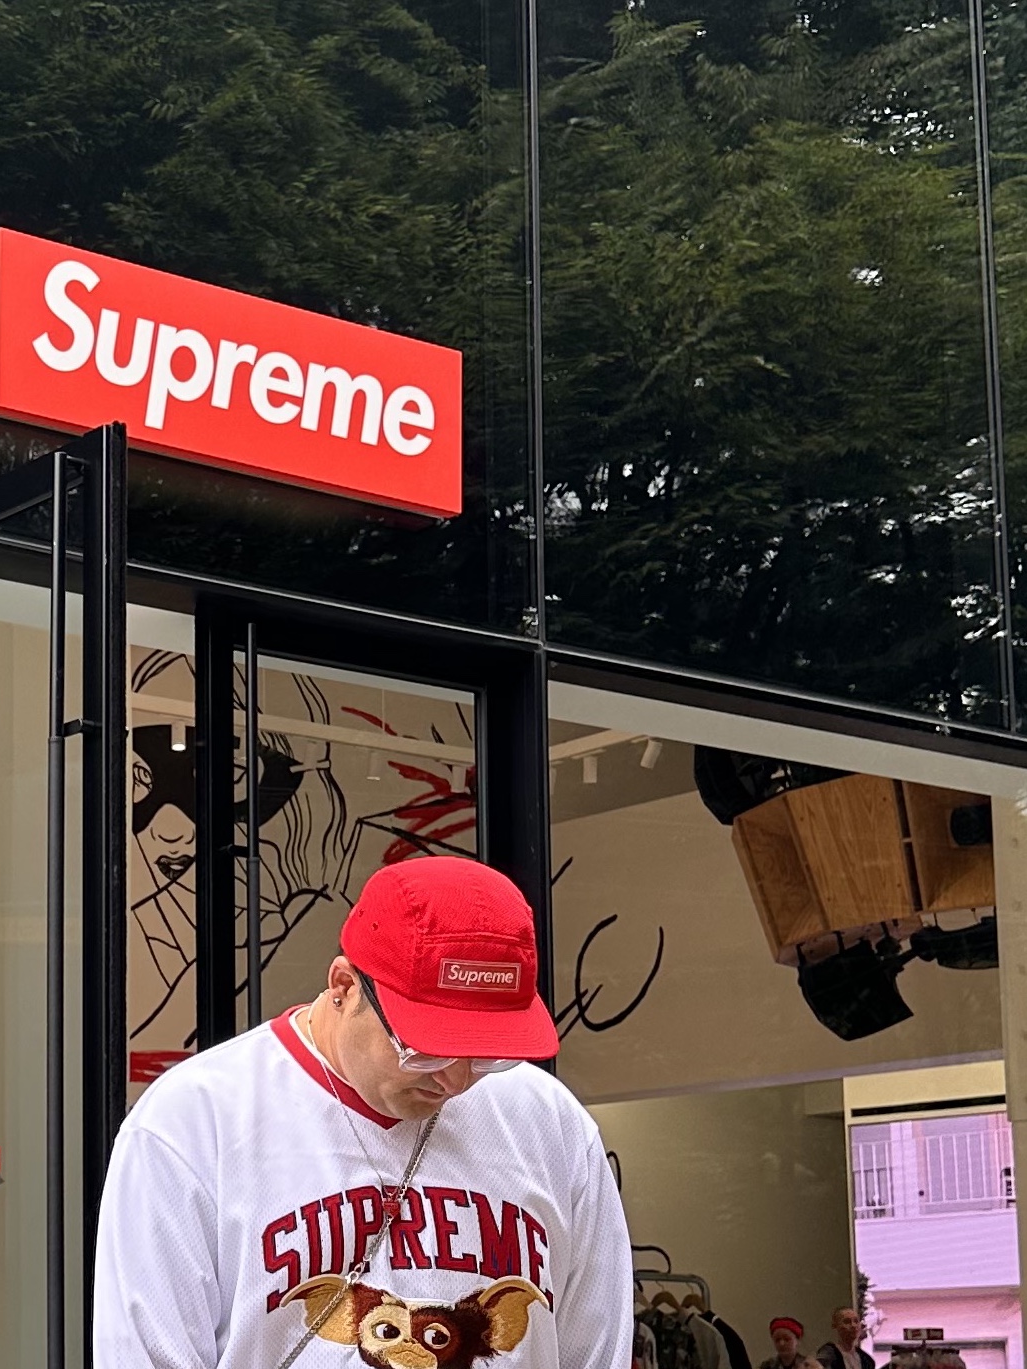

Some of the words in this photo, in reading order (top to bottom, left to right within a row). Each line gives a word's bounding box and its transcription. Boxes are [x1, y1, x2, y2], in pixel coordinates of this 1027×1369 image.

[32, 259, 435, 456] Supreme
[447, 964, 514, 986] Supreme
[261, 1184, 554, 1314] SUPREME
